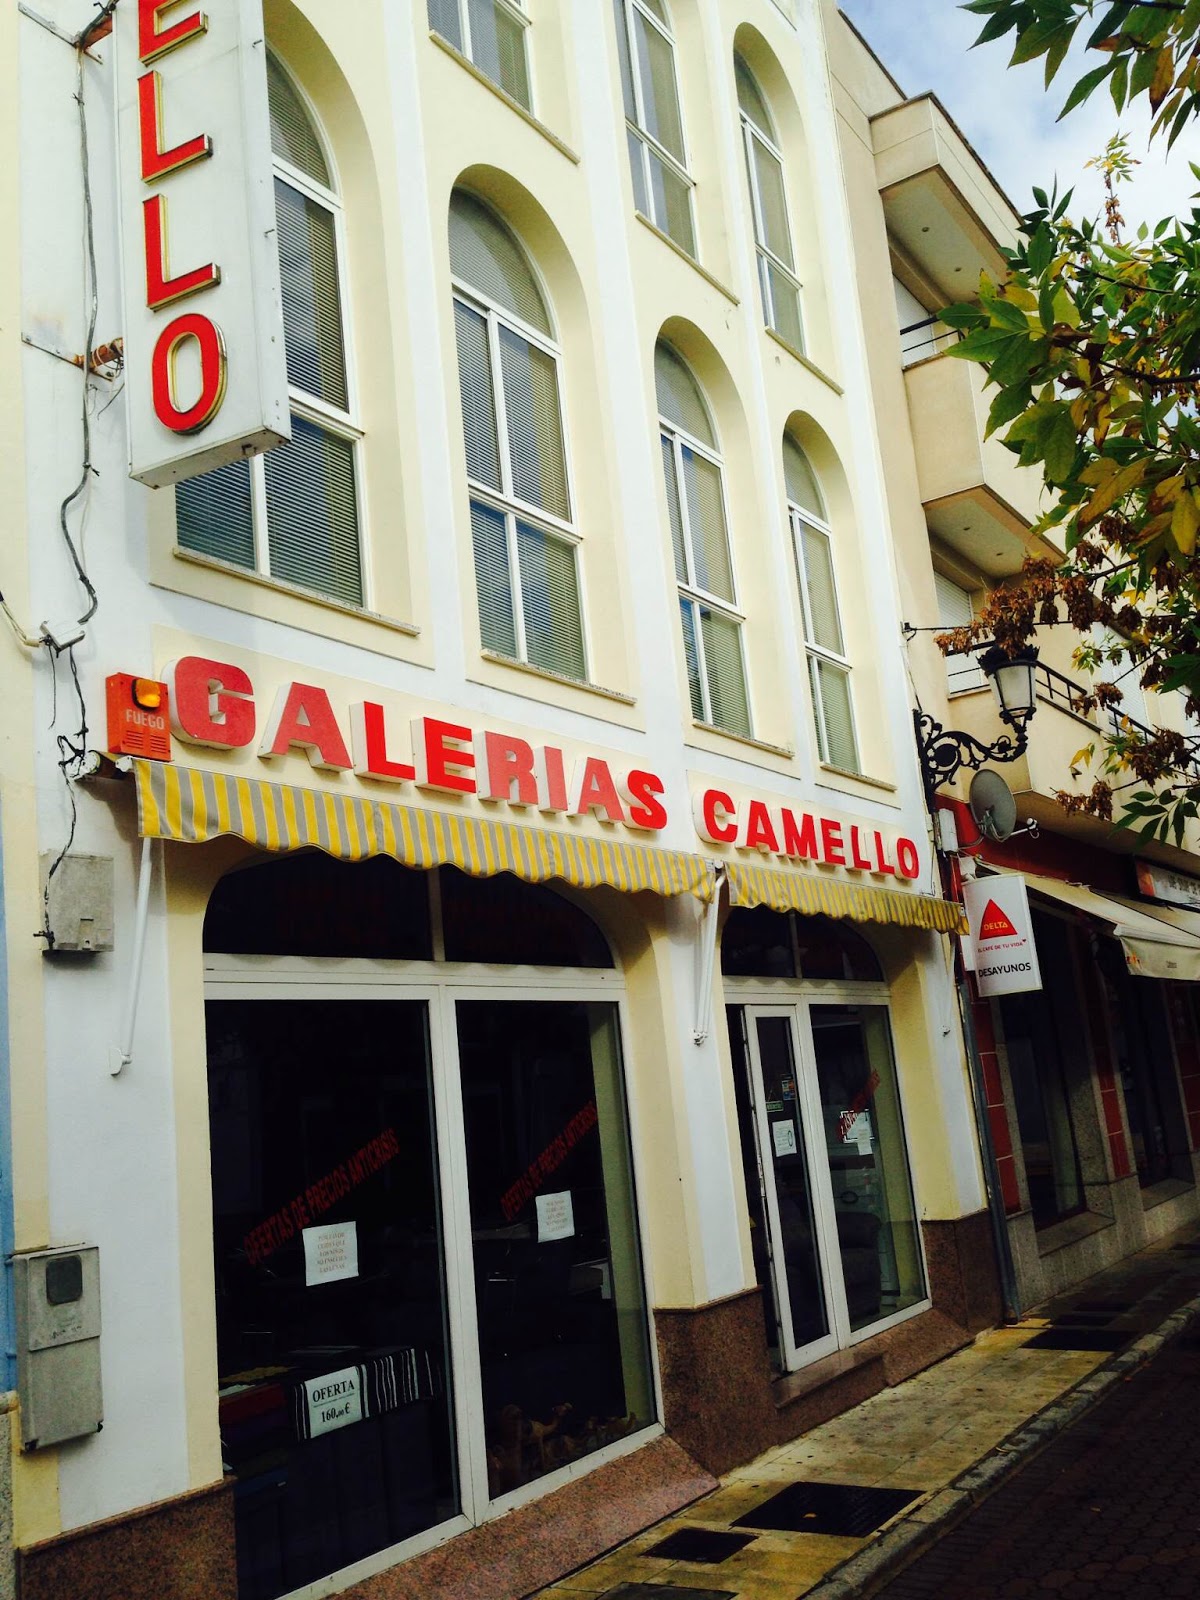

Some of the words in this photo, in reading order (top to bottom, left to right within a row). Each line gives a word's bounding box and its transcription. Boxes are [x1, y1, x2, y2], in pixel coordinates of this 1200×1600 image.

[125, 708, 165, 730] FUEGO
[168, 655, 667, 832] GALERIAS
[699, 788, 920, 880] CAMELLO
[983, 921, 1009, 931] DELTA
[978, 962, 1032, 978] DESAYUNOS
[243, 1205, 295, 1265] OFERTAS
[290, 1194, 312, 1231] DE
[305, 1163, 351, 1220] PRECIOS
[312, 1379, 355, 1402] OFERTA
